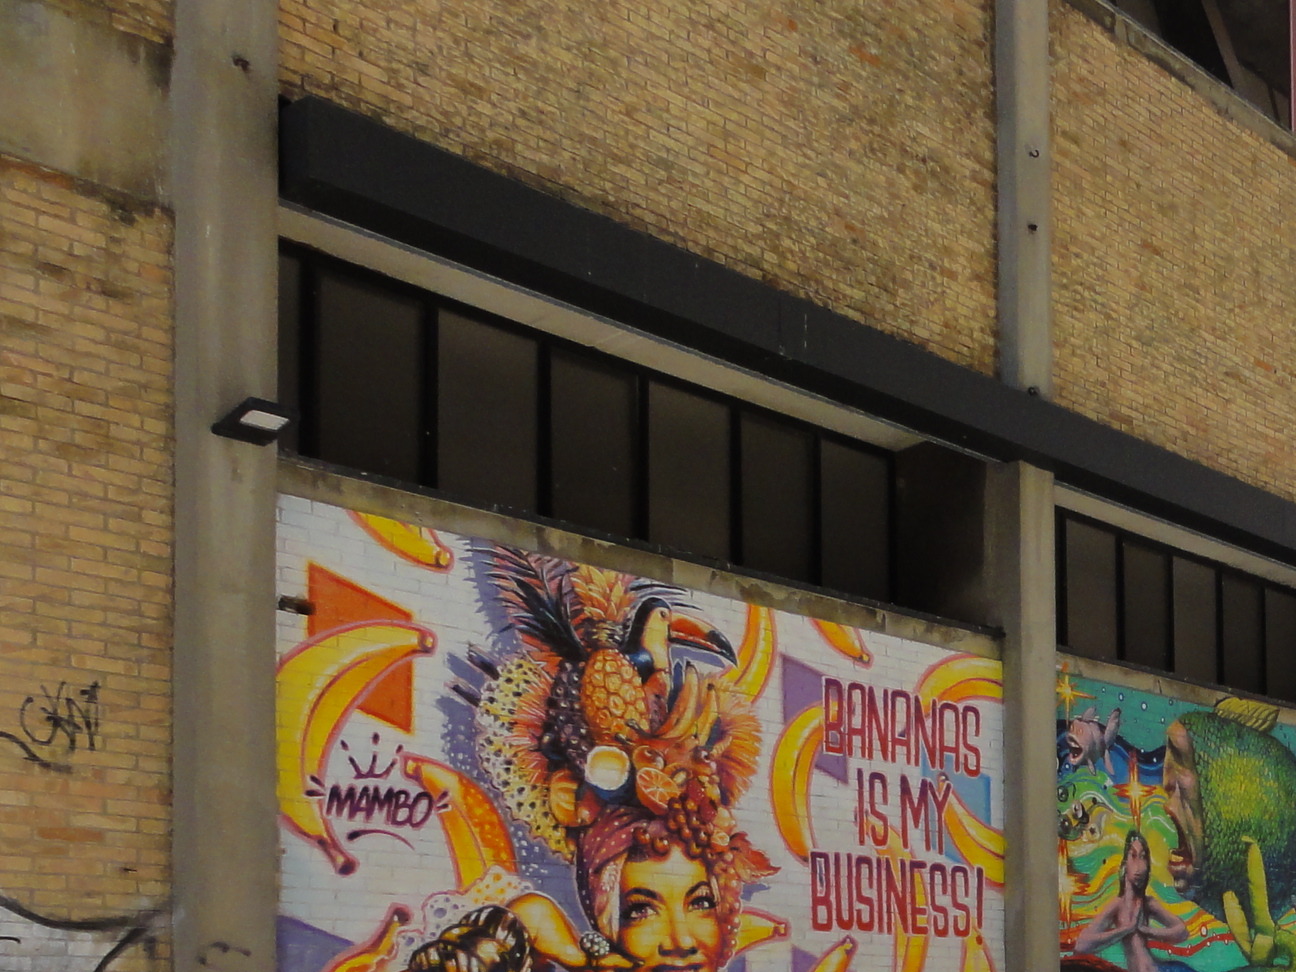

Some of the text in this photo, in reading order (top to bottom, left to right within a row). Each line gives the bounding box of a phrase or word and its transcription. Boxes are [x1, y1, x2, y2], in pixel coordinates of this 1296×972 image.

[824, 677, 981, 777] BANANAS
[326, 785, 434, 829] MAMBO
[856, 768, 951, 855] IS MY
[810, 852, 984, 945] BUSINESS!
